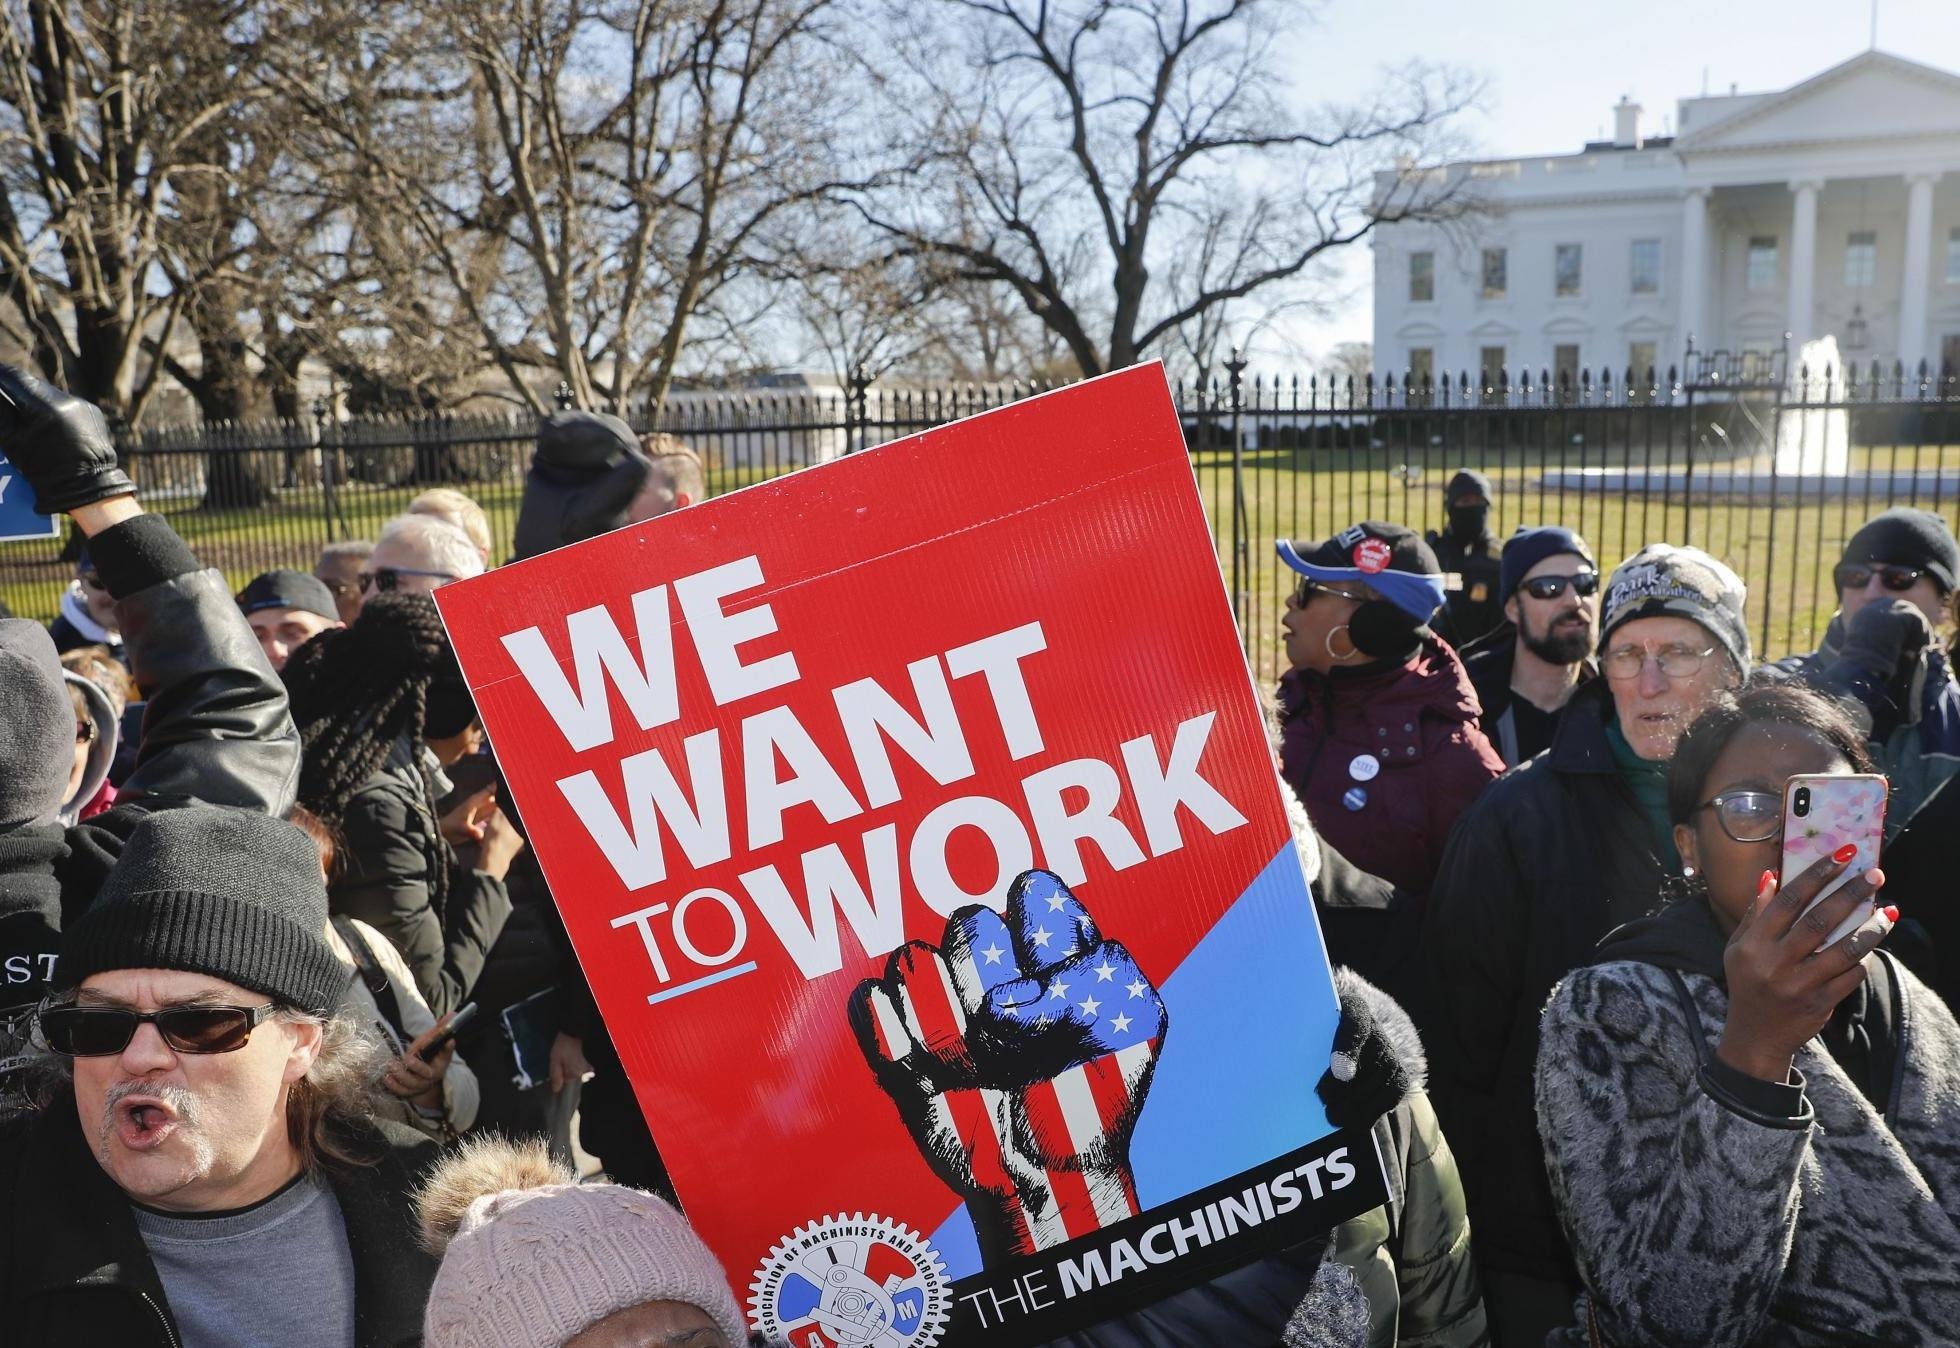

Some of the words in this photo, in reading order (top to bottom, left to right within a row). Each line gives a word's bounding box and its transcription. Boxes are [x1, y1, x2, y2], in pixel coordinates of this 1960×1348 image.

[500, 554, 801, 753] WE
[556, 620, 1048, 892] WANT
[610, 887, 748, 985] TO
[739, 711, 1249, 981] WORK
[0, 953, 59, 984] ST
[784, 1247, 799, 1262] OF
[800, 1226, 885, 1250] MACHINISTS
[888, 1235, 914, 1254] AND
[911, 1253, 940, 1317] AEROSPACE
[896, 1299, 919, 1321] M
[958, 1268, 1055, 1329] THE
[1057, 1146, 1356, 1299] MACHINISTS
